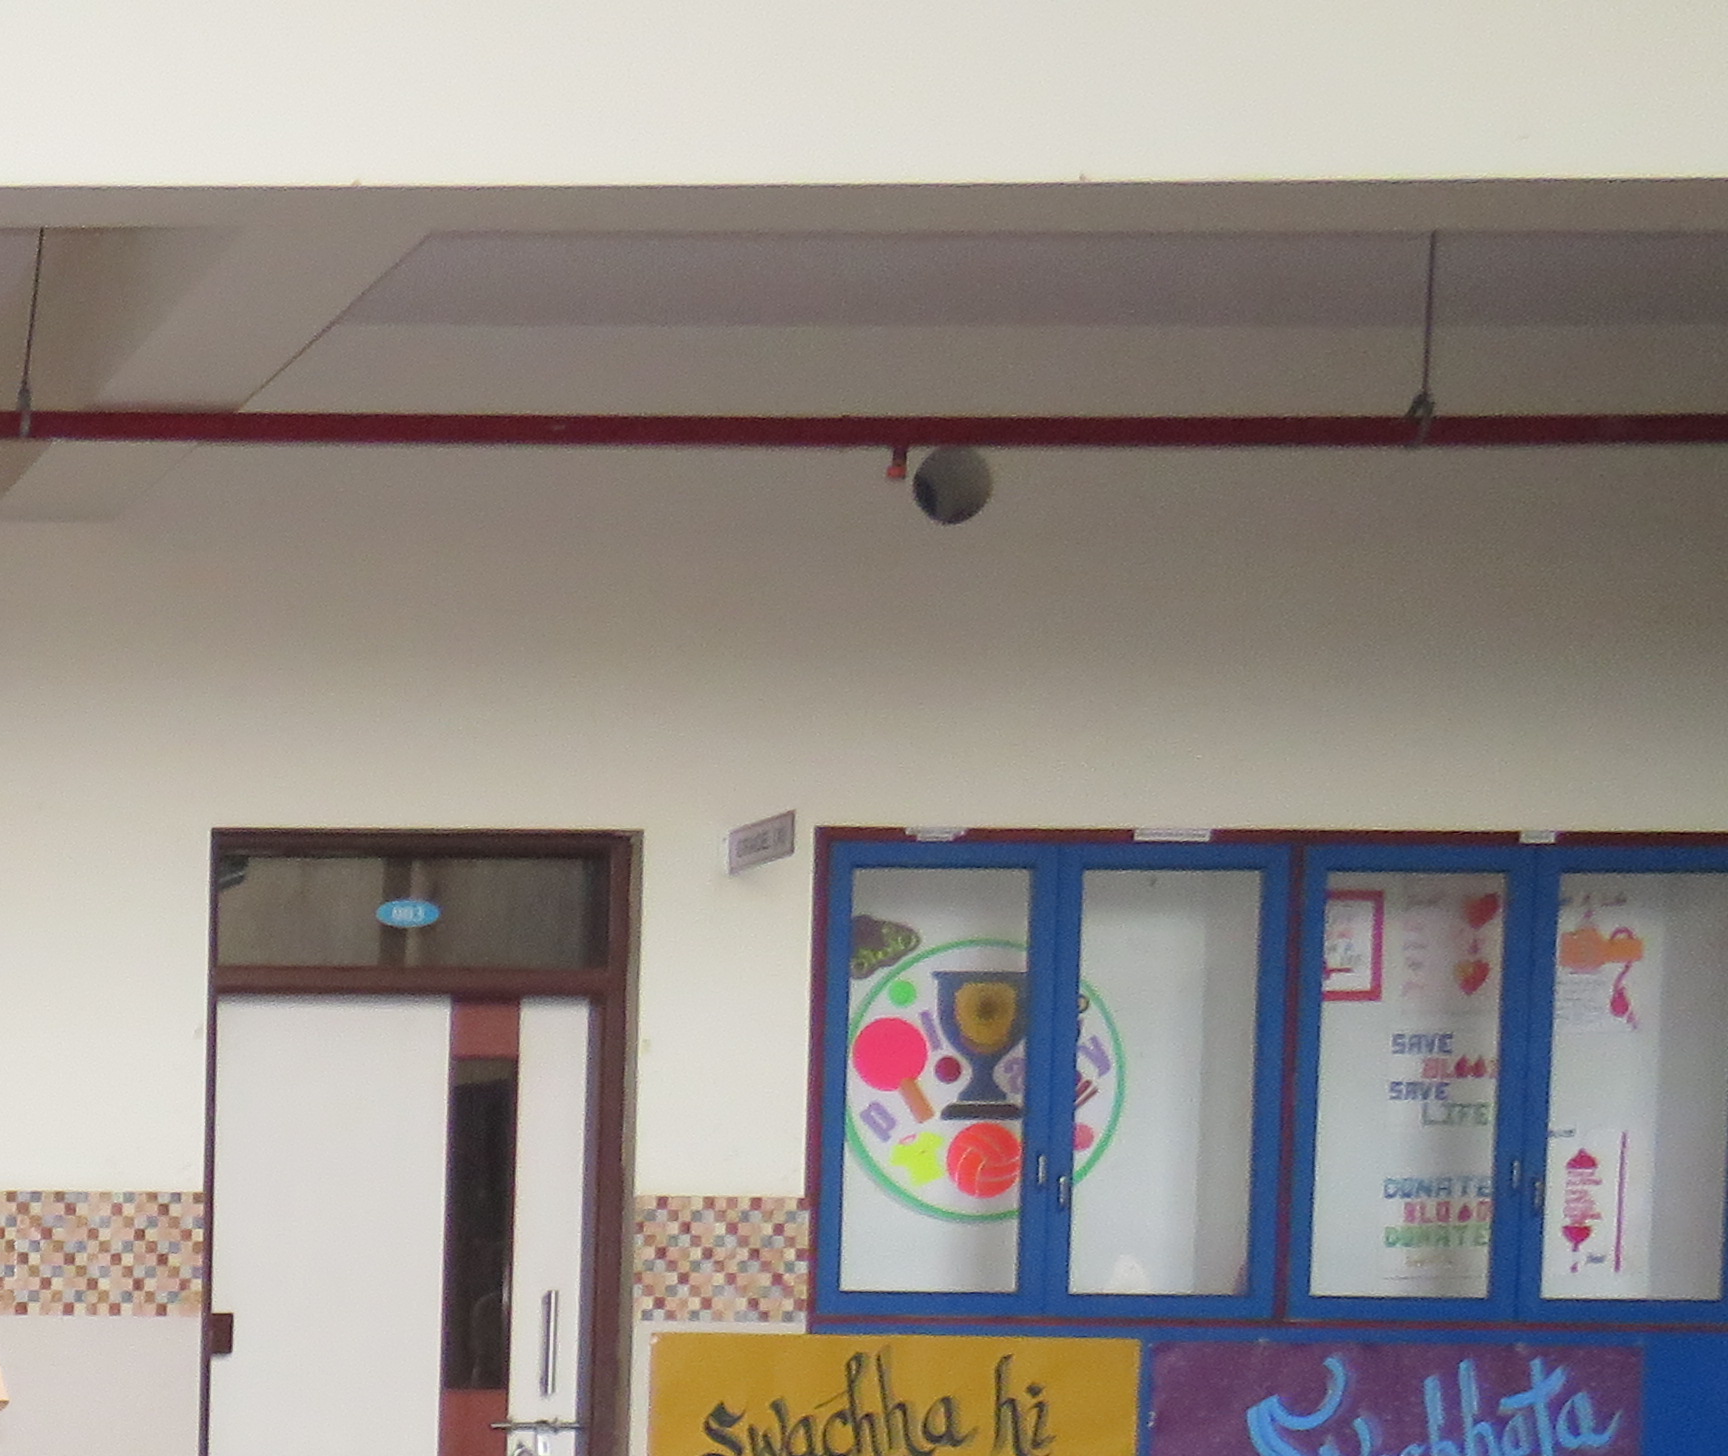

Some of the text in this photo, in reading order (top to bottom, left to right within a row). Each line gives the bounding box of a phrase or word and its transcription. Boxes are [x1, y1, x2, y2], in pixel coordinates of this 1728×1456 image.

[1392, 1033, 1454, 1055] SAVE
[1390, 1081, 1451, 1101] SAVE
[1421, 1102, 1493, 1127] LIFE
